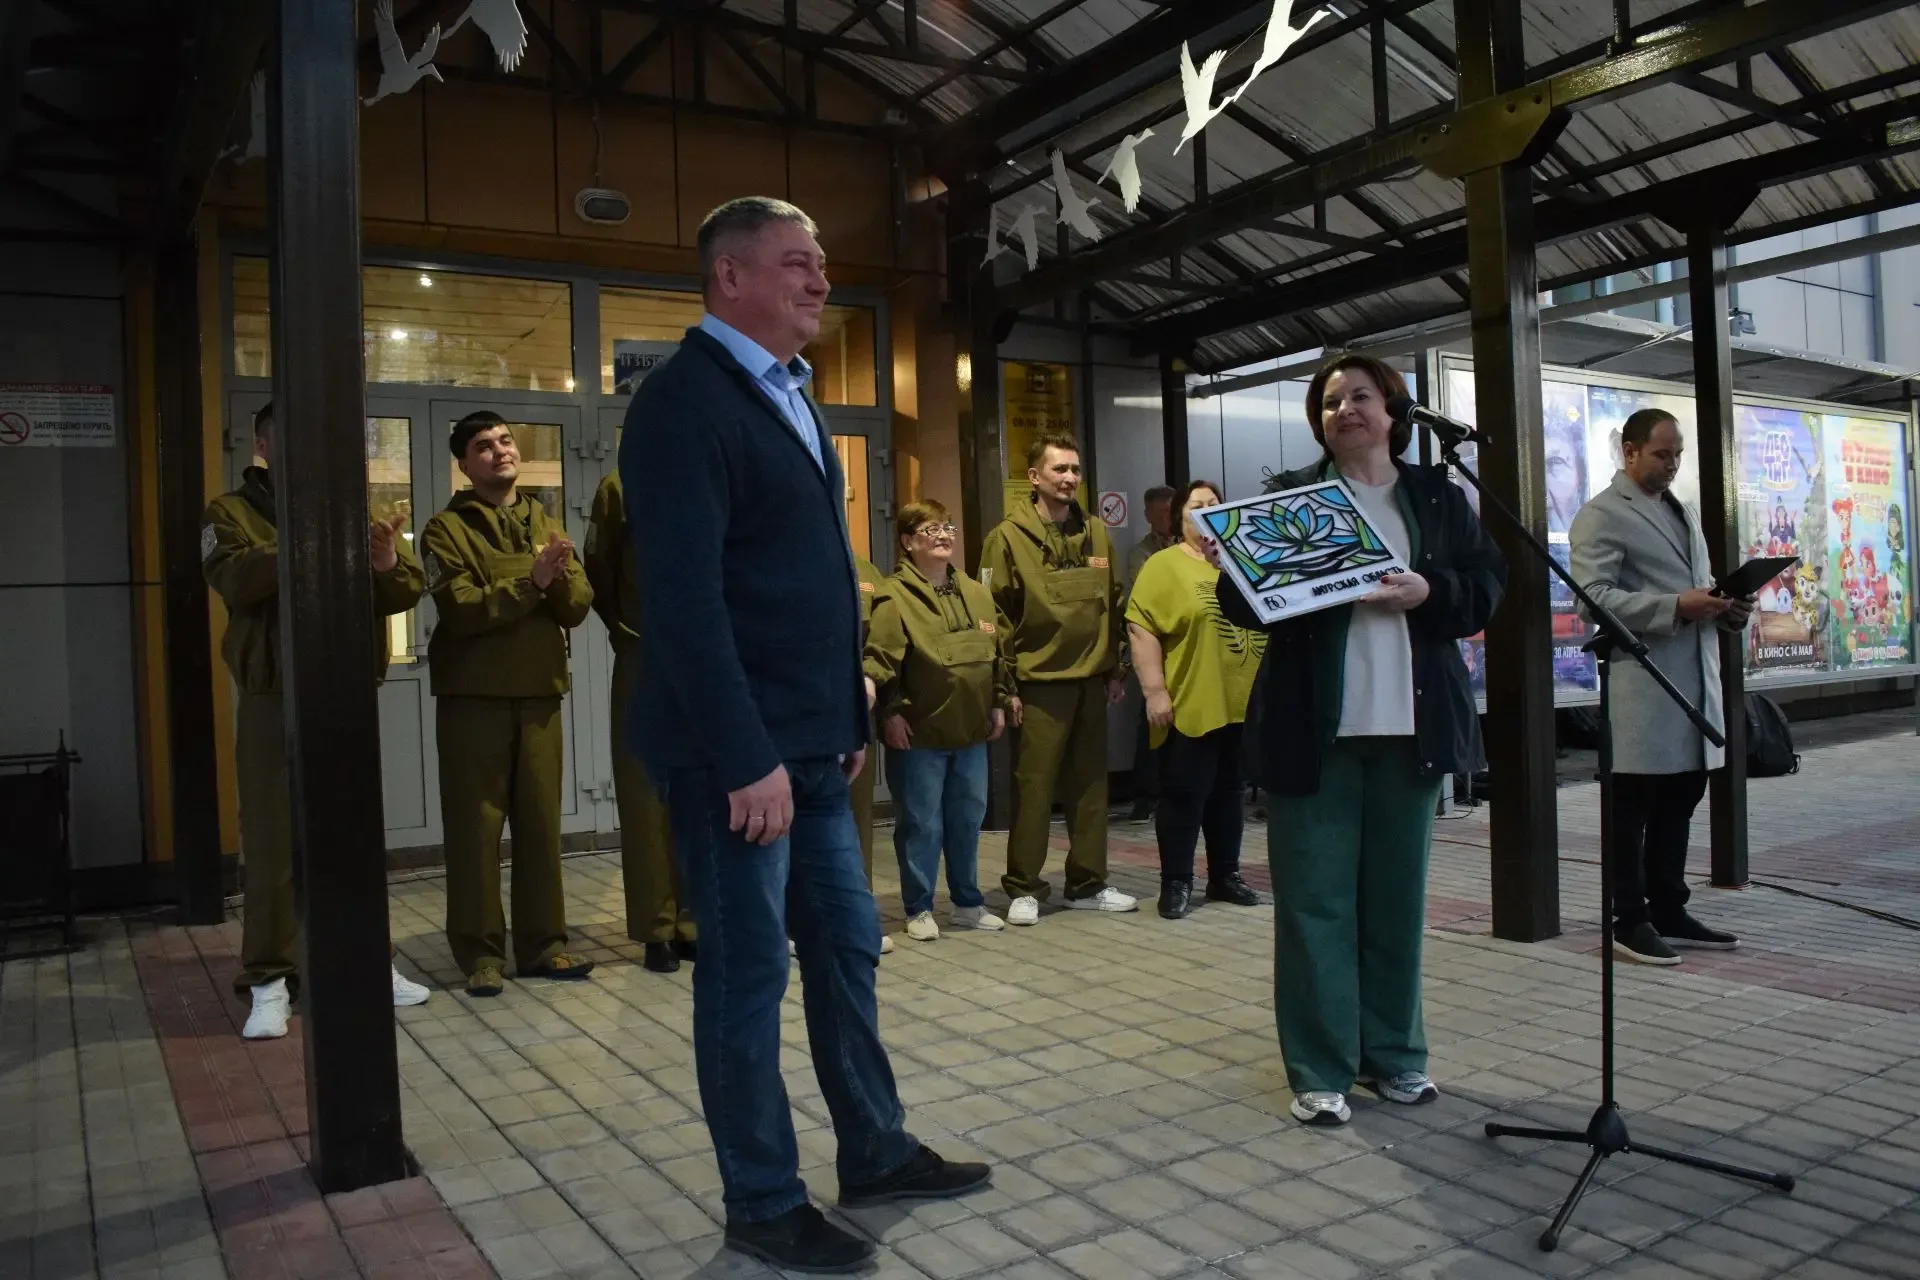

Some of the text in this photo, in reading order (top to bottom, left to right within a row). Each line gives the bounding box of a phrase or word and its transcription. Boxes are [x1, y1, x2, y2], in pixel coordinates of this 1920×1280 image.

[33, 421, 81, 431] ЗАПРЕЩЕНО
[1311, 577, 1360, 597] АМУРСКАЯ
[1554, 646, 1562, 658] 30
[1758, 644, 1813, 659] В КИНО С 14 МАЯ
